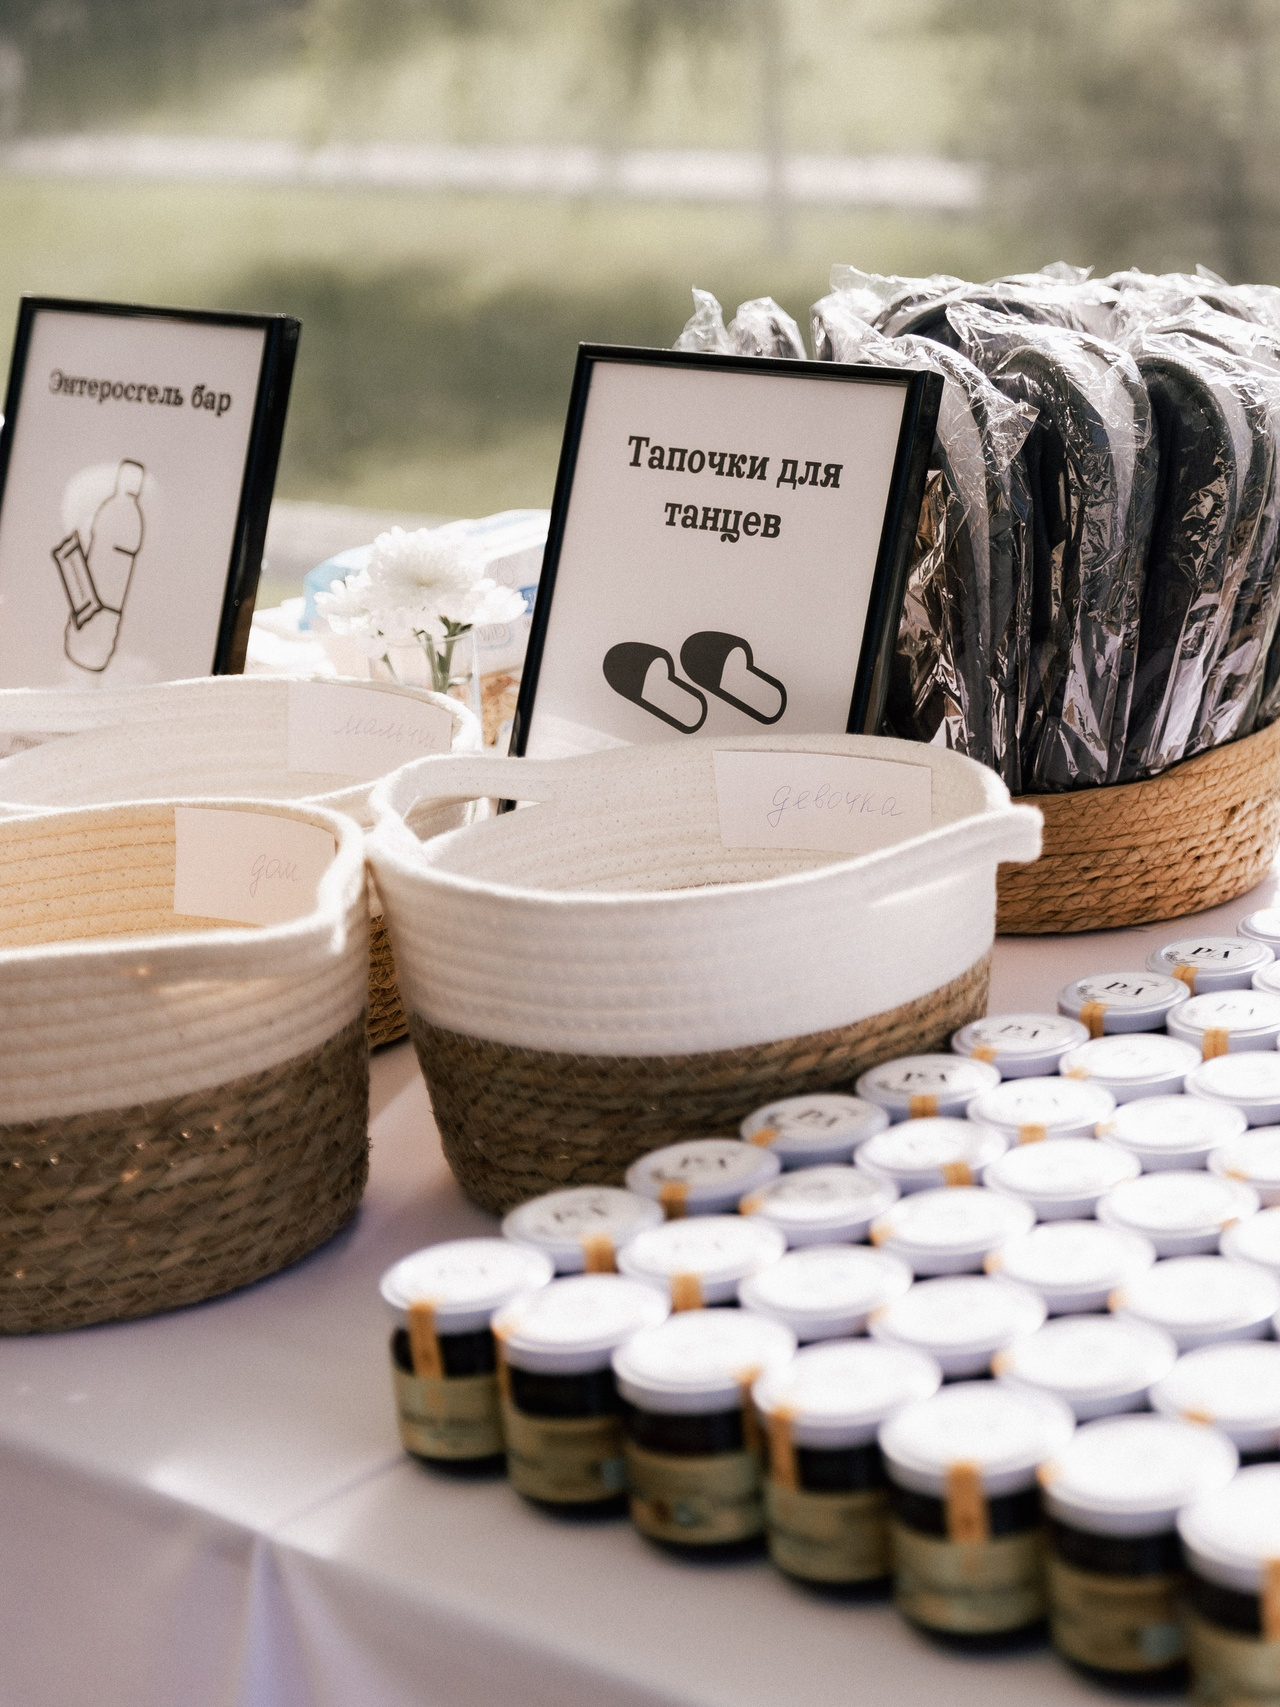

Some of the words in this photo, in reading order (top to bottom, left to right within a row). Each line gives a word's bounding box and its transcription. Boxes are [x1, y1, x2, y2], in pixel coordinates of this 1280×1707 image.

[49, 368, 184, 407] Энтеросгель
[191, 384, 233, 418] бар
[627, 435, 771, 481] Тапочки
[776, 458, 844, 491] для
[663, 502, 782, 544] танцев
[766, 783, 904, 829] девочка
